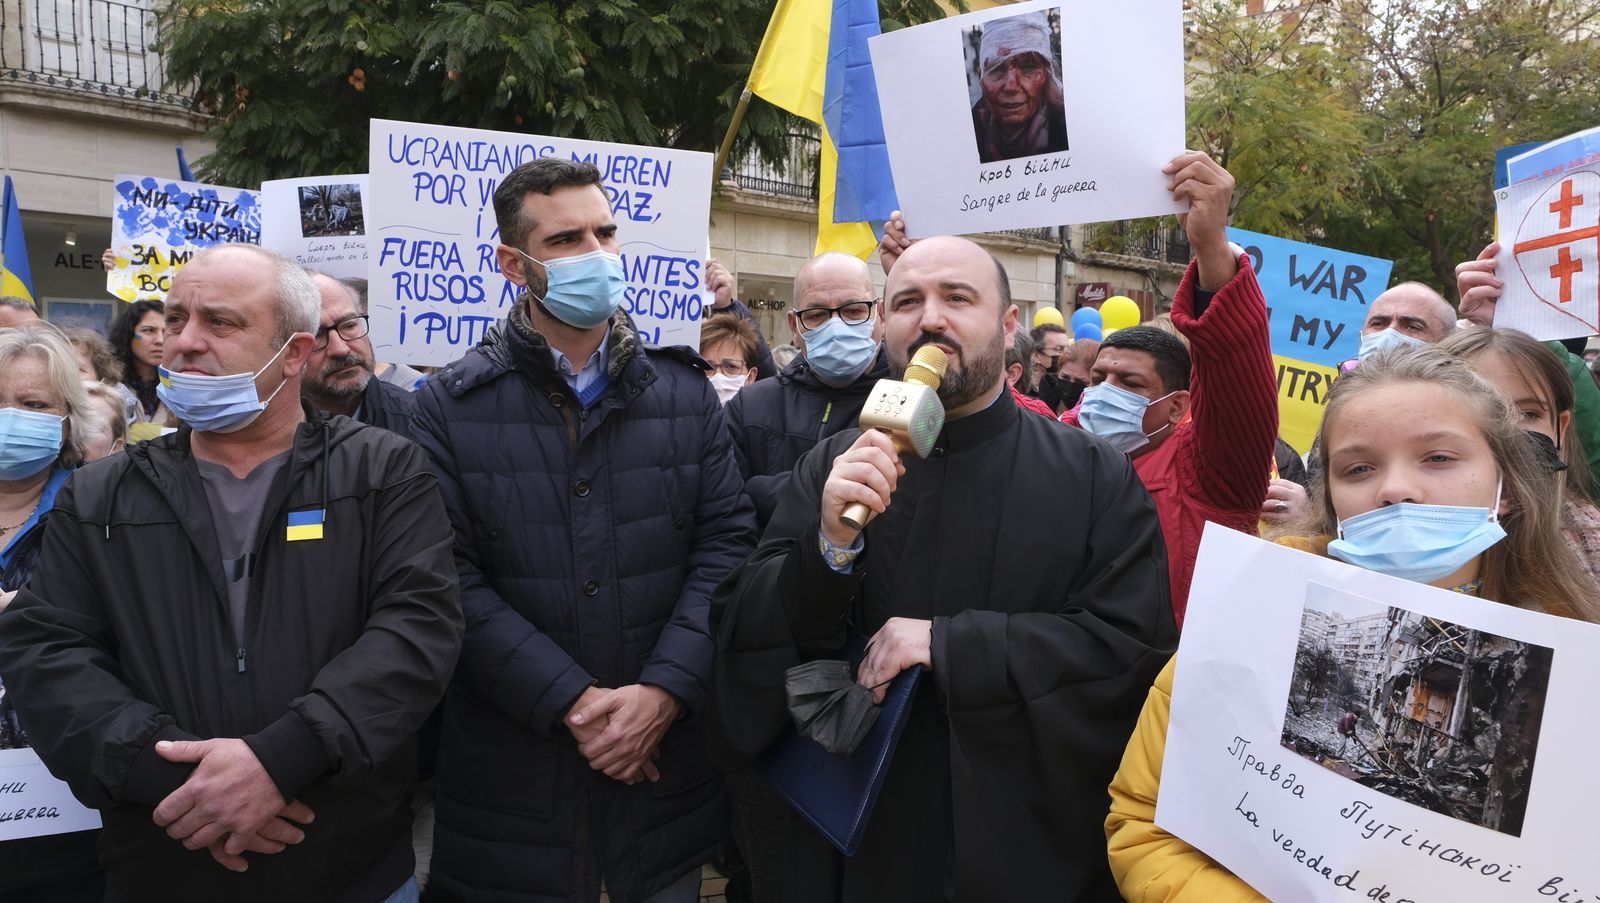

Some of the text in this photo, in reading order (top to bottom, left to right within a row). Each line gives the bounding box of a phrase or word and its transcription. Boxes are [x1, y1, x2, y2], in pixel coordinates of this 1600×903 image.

[412, 171, 468, 208] POR
[960, 180, 1098, 212] Sangre de la guerra
[184, 218, 261, 245] УКРАЇН
[54, 252, 105, 271] ALE-
[130, 244, 160, 266] ЗА
[379, 237, 465, 273] FUERA
[1289, 254, 1368, 305] WAR
[747, 299, 786, 311] ALE-HOP
[1289, 314, 1346, 350] MY
[1227, 736, 1305, 799] Правда
[1340, 800, 1522, 883] Путінської
[1235, 791, 1391, 903] La verdad de
